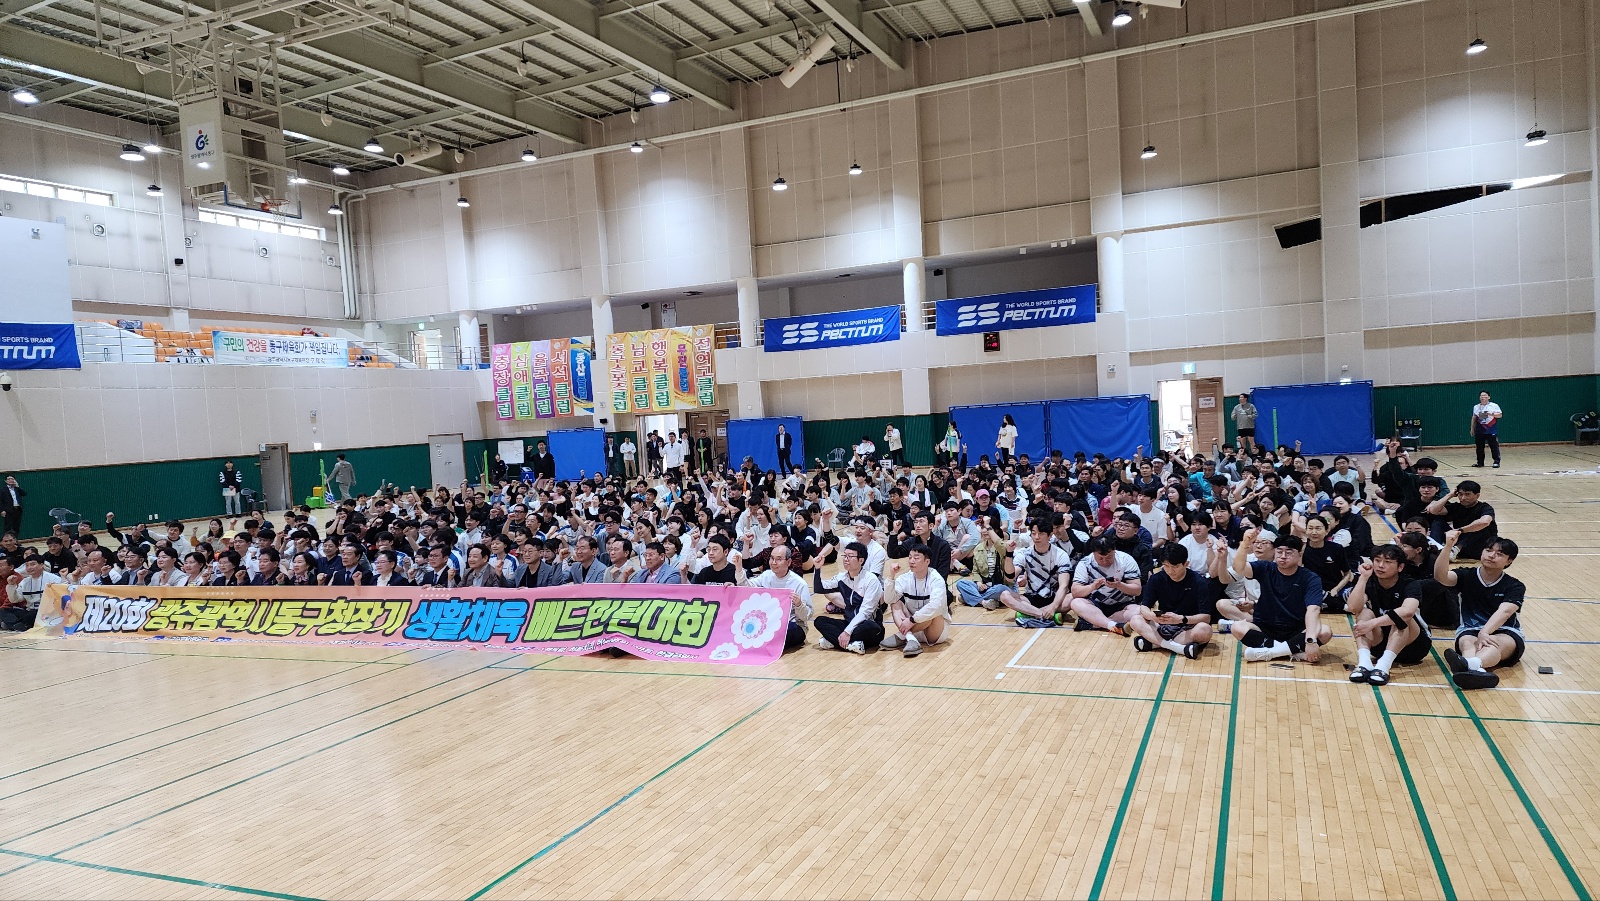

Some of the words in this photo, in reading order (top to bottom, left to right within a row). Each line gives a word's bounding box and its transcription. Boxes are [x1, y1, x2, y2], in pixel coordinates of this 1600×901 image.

[222, 337, 245, 352] 구민의
[246, 338, 268, 353] 건강을
[849, 319, 867, 327] SPORTS
[867, 317, 884, 325] BRAND
[493, 355, 512, 418] 충장클럽
[513, 352, 532, 416] 삼애클럽
[533, 352, 552, 414] 율곡클럽
[551, 349, 571, 414] 서석클럽
[651, 339, 671, 408] 행복클럽
[695, 337, 715, 407] 전여고클럽
[78, 596, 158, 634] 제20회
[143, 595, 412, 638] 광주광역시동구청장기
[402, 598, 529, 644] 생활체육
[522, 598, 721, 648] 배드민턴대회
